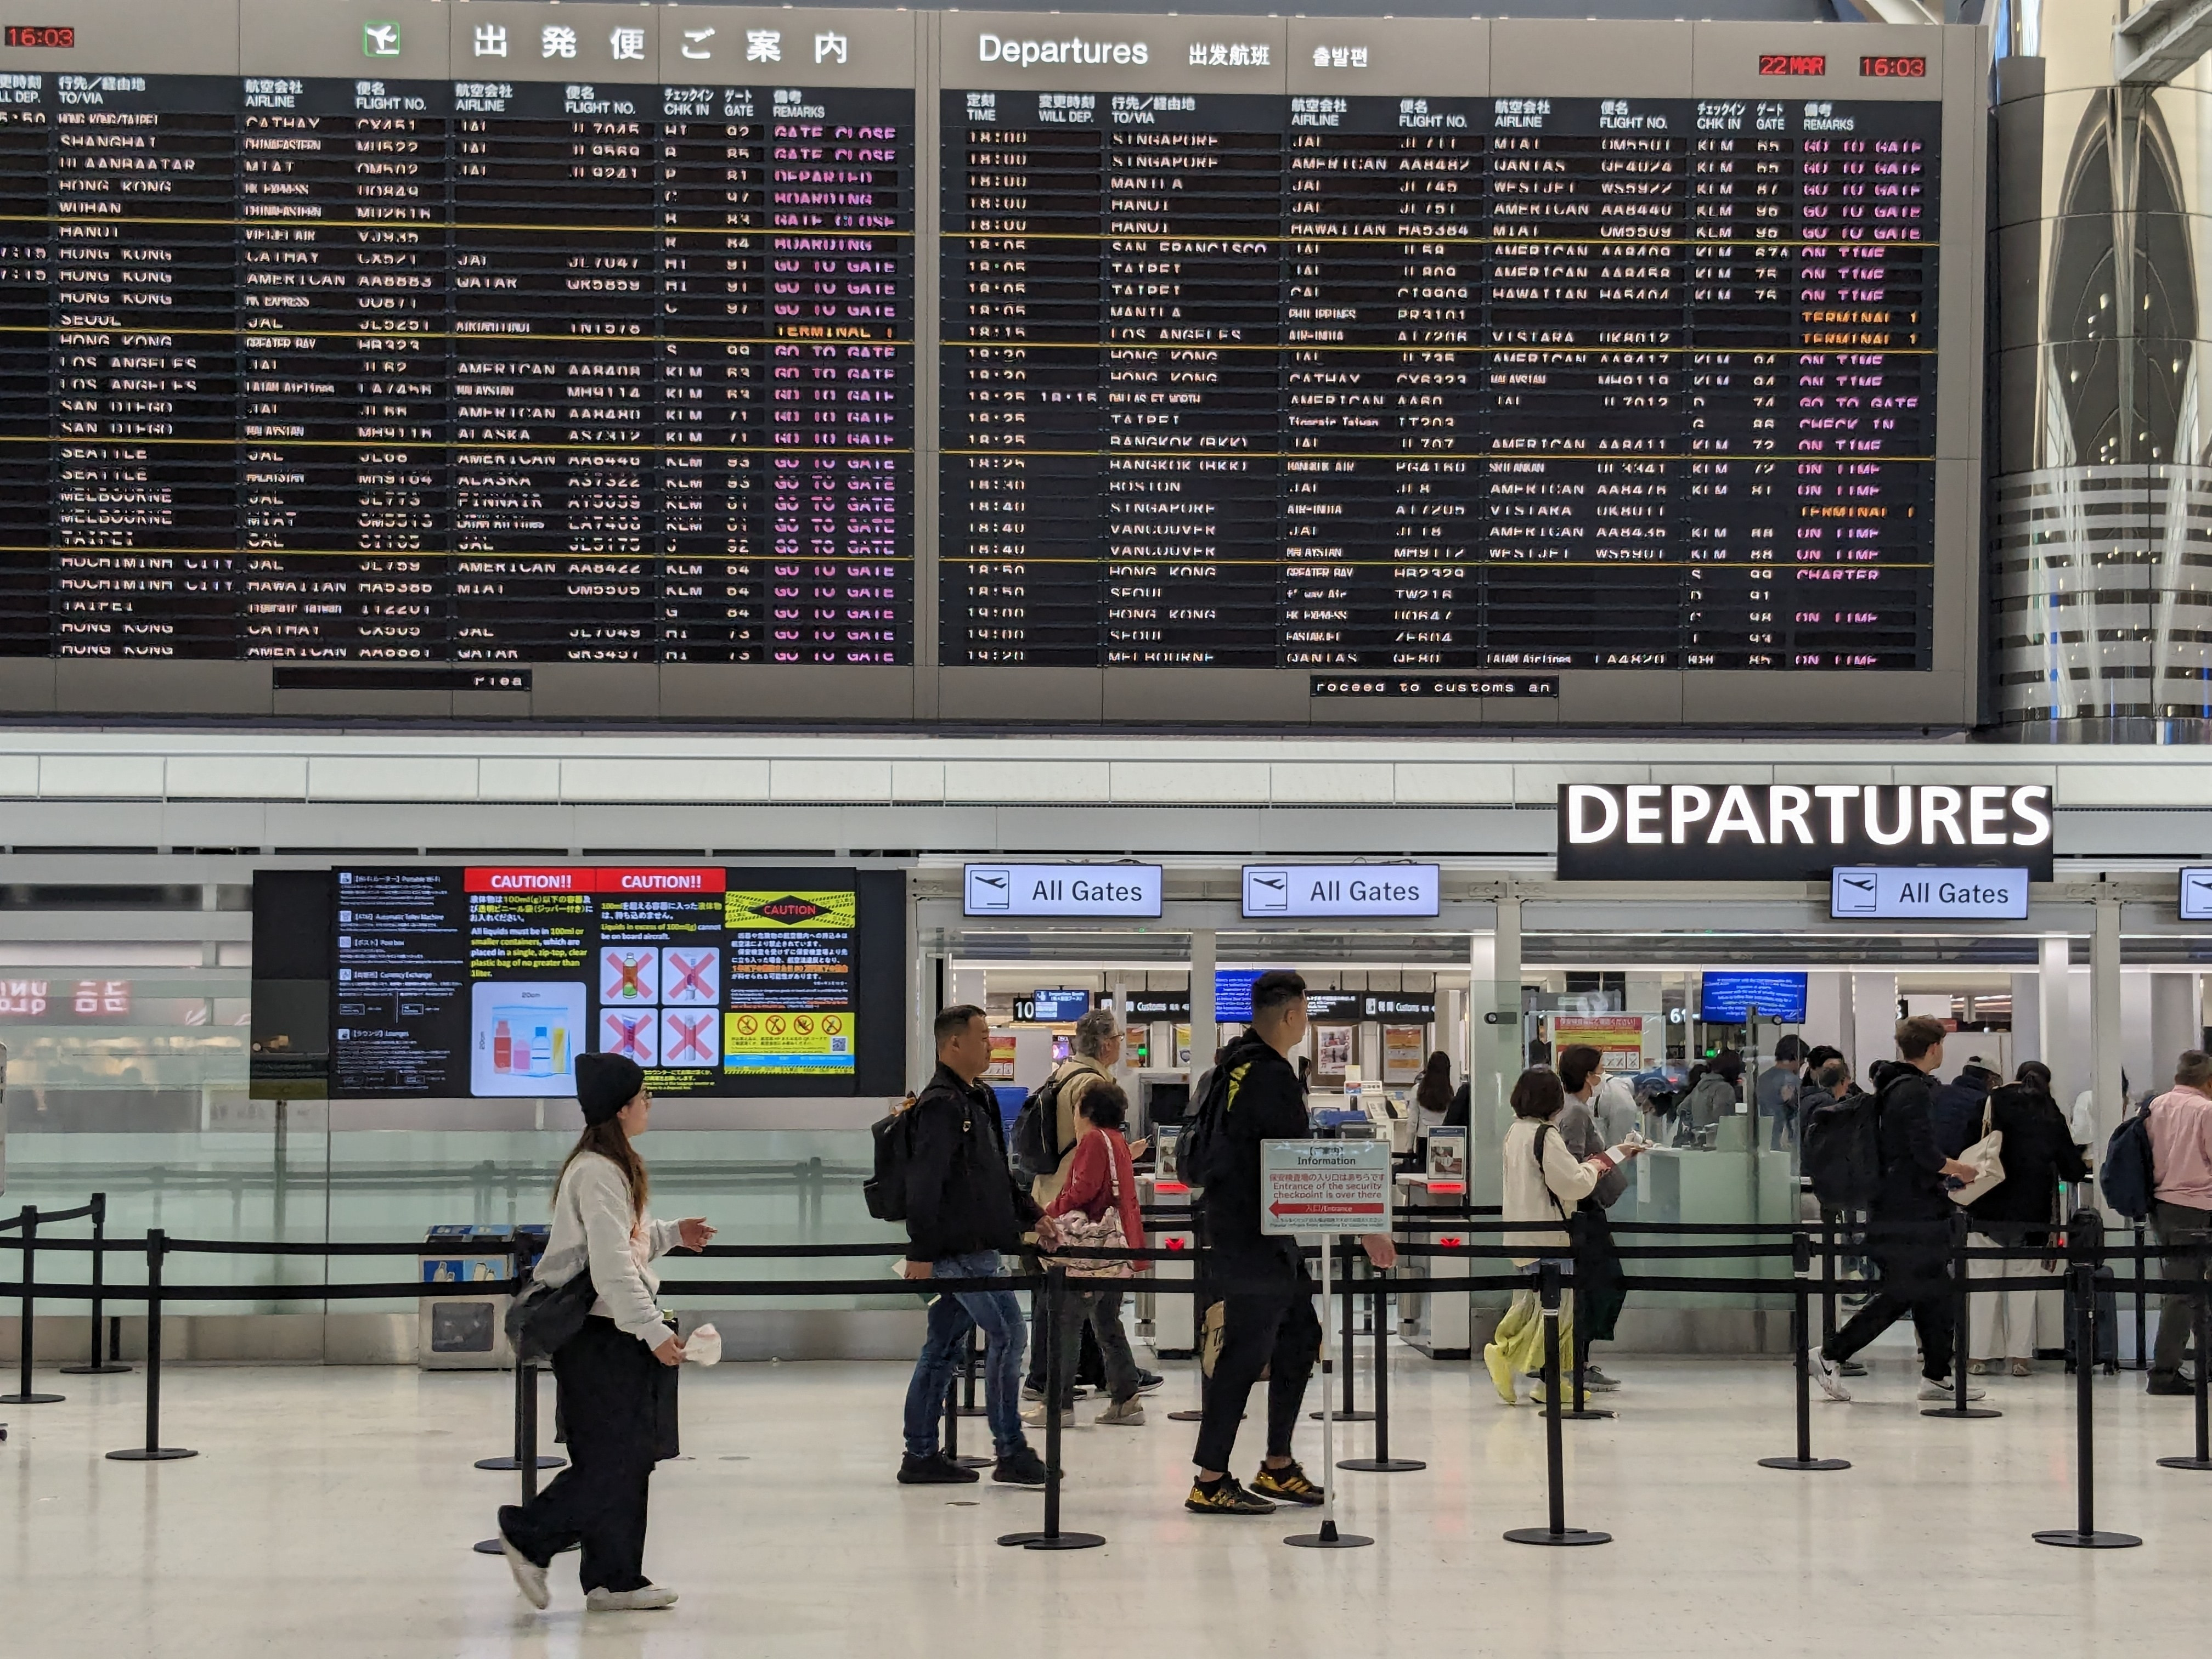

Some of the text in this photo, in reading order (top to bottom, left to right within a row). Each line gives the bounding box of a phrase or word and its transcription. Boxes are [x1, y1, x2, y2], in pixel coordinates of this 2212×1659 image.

[10, 29, 72, 46] 16:03
[980, 35, 1148, 67] Departures
[1189, 43, 1270, 66] 出发航班
[1312, 47, 1368, 68] 출발편
[1760, 57, 1824, 75] 22 MAR
[1863, 58, 1925, 76] 16:03
[59, 91, 104, 104] TO/VIA
[245, 94, 295, 108] AIRLINE
[664, 87, 714, 102] チェックイン
[725, 89, 752, 103] ゲート
[356, 97, 427, 110] FLIGHT NO.
[456, 99, 505, 112] AIRLINE
[565, 101, 636, 115] FLIGHT NO.
[664, 103, 709, 116] CHK IN
[1697, 101, 1746, 116] チェックイン
[1757, 102, 1783, 117] ゲート
[724, 104, 754, 117] GATE
[772, 105, 825, 119] REMARKS
[966, 108, 996, 121] TIME
[1039, 110, 1068, 123] WILL
[1111, 110, 1155, 124] TO/VIA
[1291, 113, 1339, 126] AIRLINE
[1399, 114, 1468, 128] FLIGHT NO.
[1494, 115, 1542, 128] AIRLINE
[1600, 116, 1668, 129] FLIGHT NO.
[1696, 117, 1741, 129] CHK IN
[1756, 117, 1785, 130] GATE
[1803, 118, 1854, 131] REMARKS
[1400, 682, 1419, 692] to
[1434, 683, 1514, 692] customs
[1568, 785, 2050, 845] DEPARTURES
[492, 875, 571, 888] CAUTION!!
[622, 875, 701, 888] CAUTION!!
[1032, 880, 1142, 901] All Gates
[1310, 881, 1419, 901] All Gates
[1899, 882, 2008, 904] All Gates
[764, 905, 816, 915] CAUTION
[1015, 1001, 1034, 1018] 10
[1297, 1156, 1356, 1165] Information
[1346, 1182, 1382, 1191] security
[1273, 1190, 1323, 1200] checkpoint
